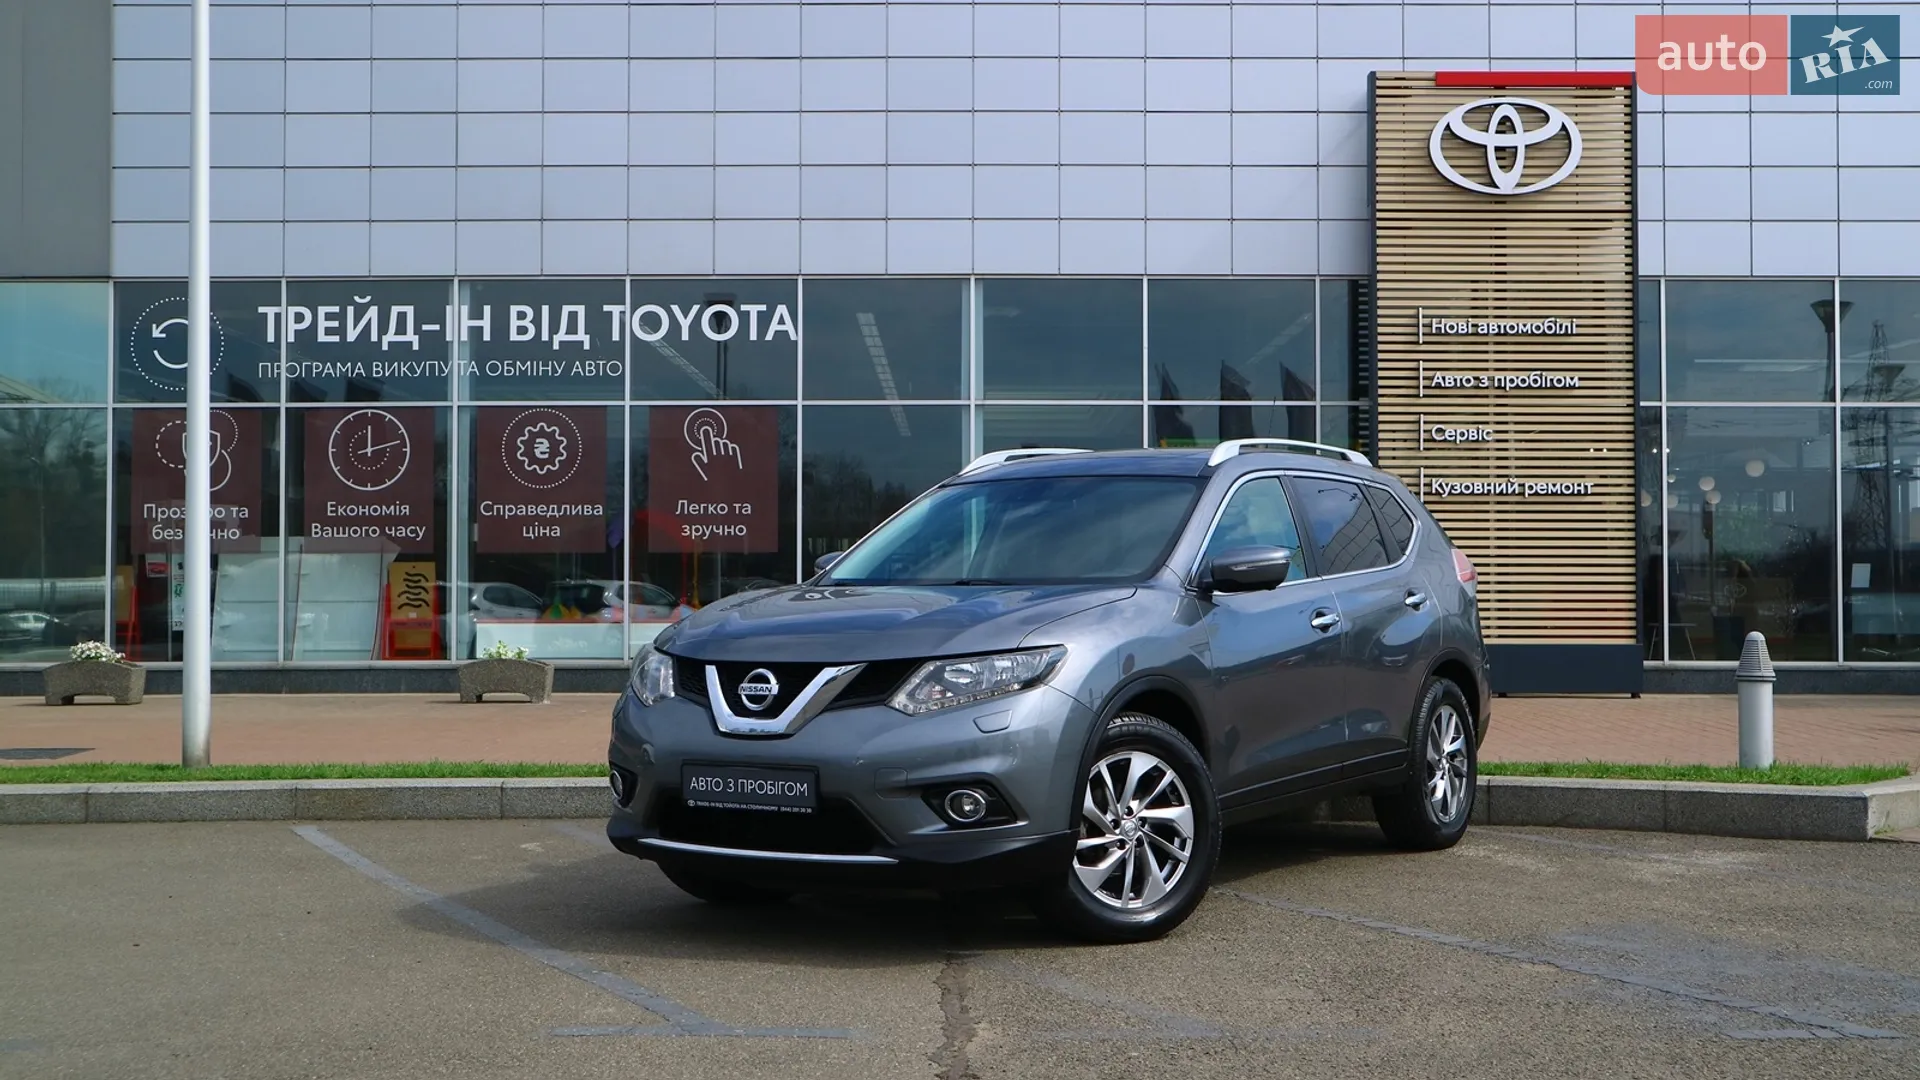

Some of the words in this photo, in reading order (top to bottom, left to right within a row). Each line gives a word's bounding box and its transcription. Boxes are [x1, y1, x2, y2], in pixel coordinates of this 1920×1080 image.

[257, 295, 491, 351] ТРЕЙД-ІН
[509, 304, 590, 350] ВІД
[602, 303, 798, 343] TOYOTA
[1431, 318, 1472, 335] Нові
[1477, 318, 1577, 335] автомобілі
[258, 361, 366, 378] ПРОГРАМА
[373, 360, 450, 378] ВИКУПУ
[457, 360, 480, 377] ТА
[485, 360, 566, 377] ОБМІНУ
[571, 360, 623, 376] АВТО
[1431, 372, 1474, 388] Авто
[1478, 375, 1490, 388] з
[1494, 372, 1580, 391] пробігом
[1431, 425, 1494, 444] Сервіс
[1431, 478, 1520, 497] Кузовний
[1524, 480, 1594, 497] ремонт
[230, 506, 249, 519] та
[326, 501, 410, 517] Економія
[480, 500, 604, 520] Справедлива
[675, 500, 728, 516] Легко
[732, 503, 752, 515] та
[311, 523, 380, 538] Вашого
[386, 526, 426, 541] часу
[522, 522, 561, 539] ціна
[680, 523, 747, 540] зручно
[740, 685, 773, 694] NISSAN
[689, 776, 723, 792] АВТО
[738, 779, 808, 797] ПРОБІГОМ
